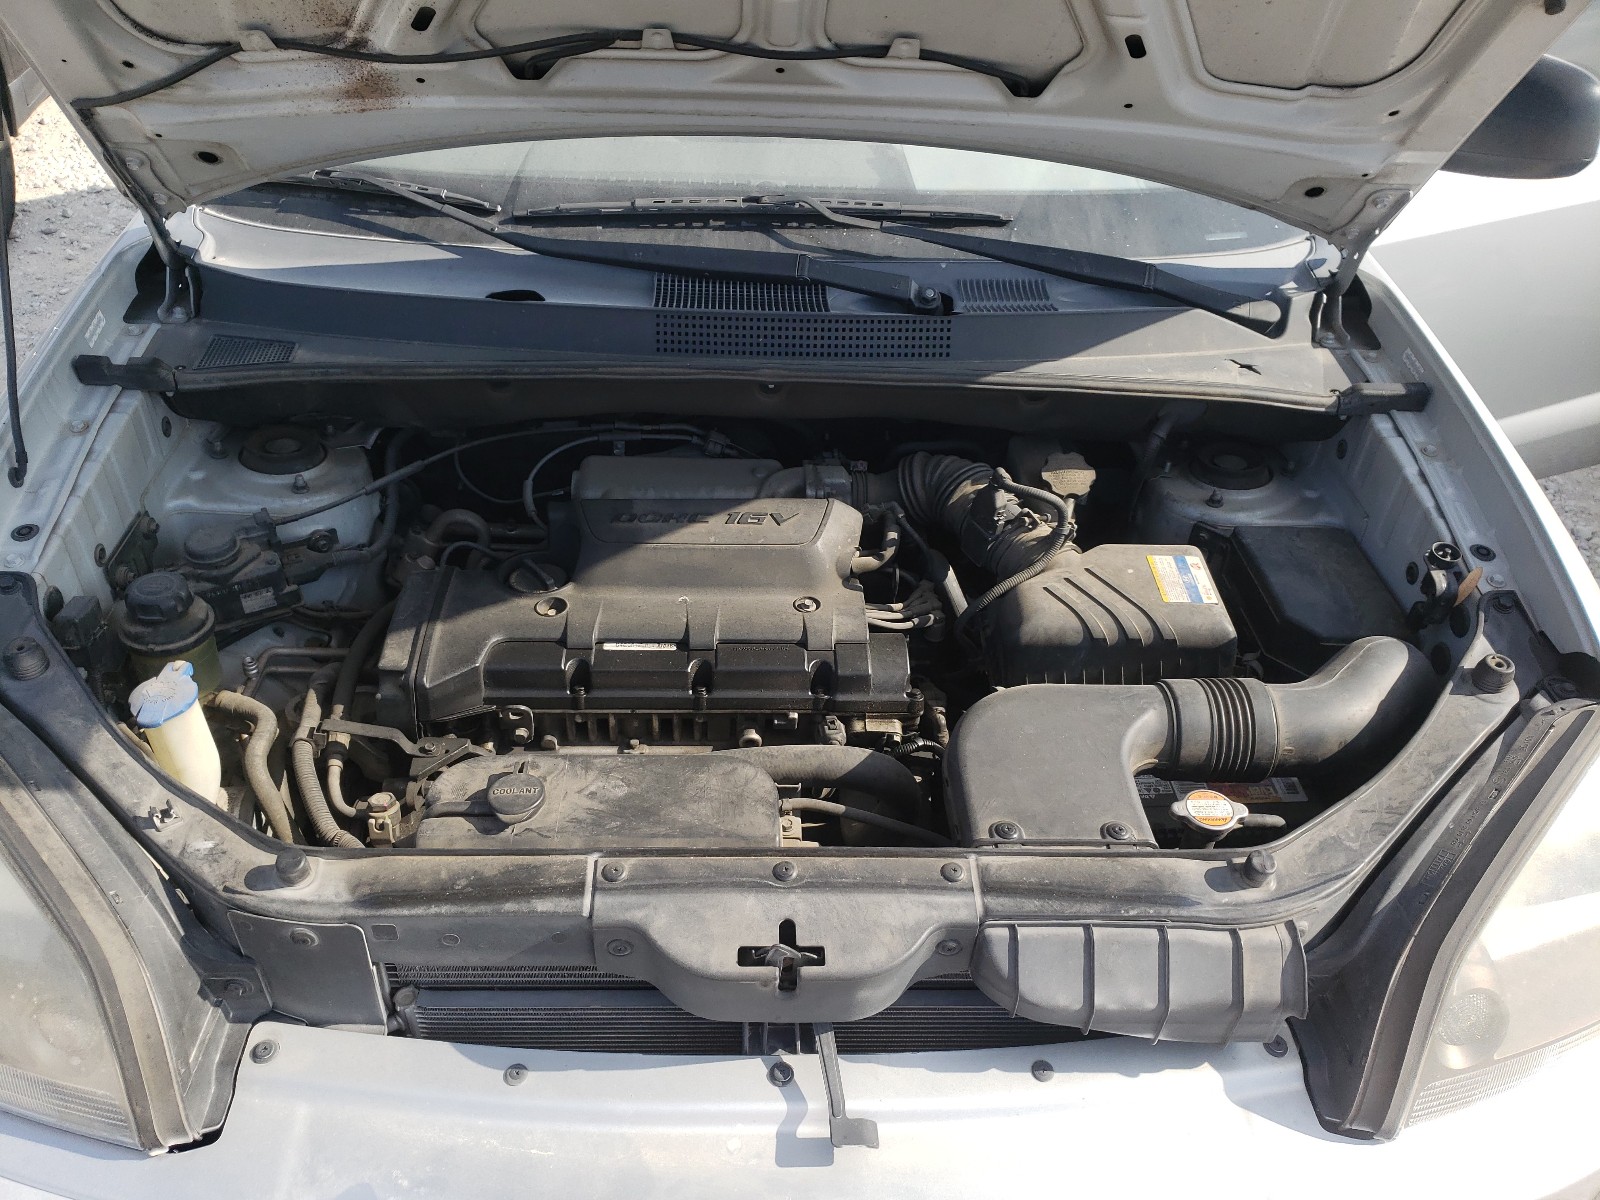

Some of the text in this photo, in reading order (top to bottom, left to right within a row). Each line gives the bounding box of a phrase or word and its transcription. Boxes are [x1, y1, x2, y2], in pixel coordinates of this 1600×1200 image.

[611, 511, 800, 527] DOHC 16V
[492, 787, 539, 796] COOLANT
